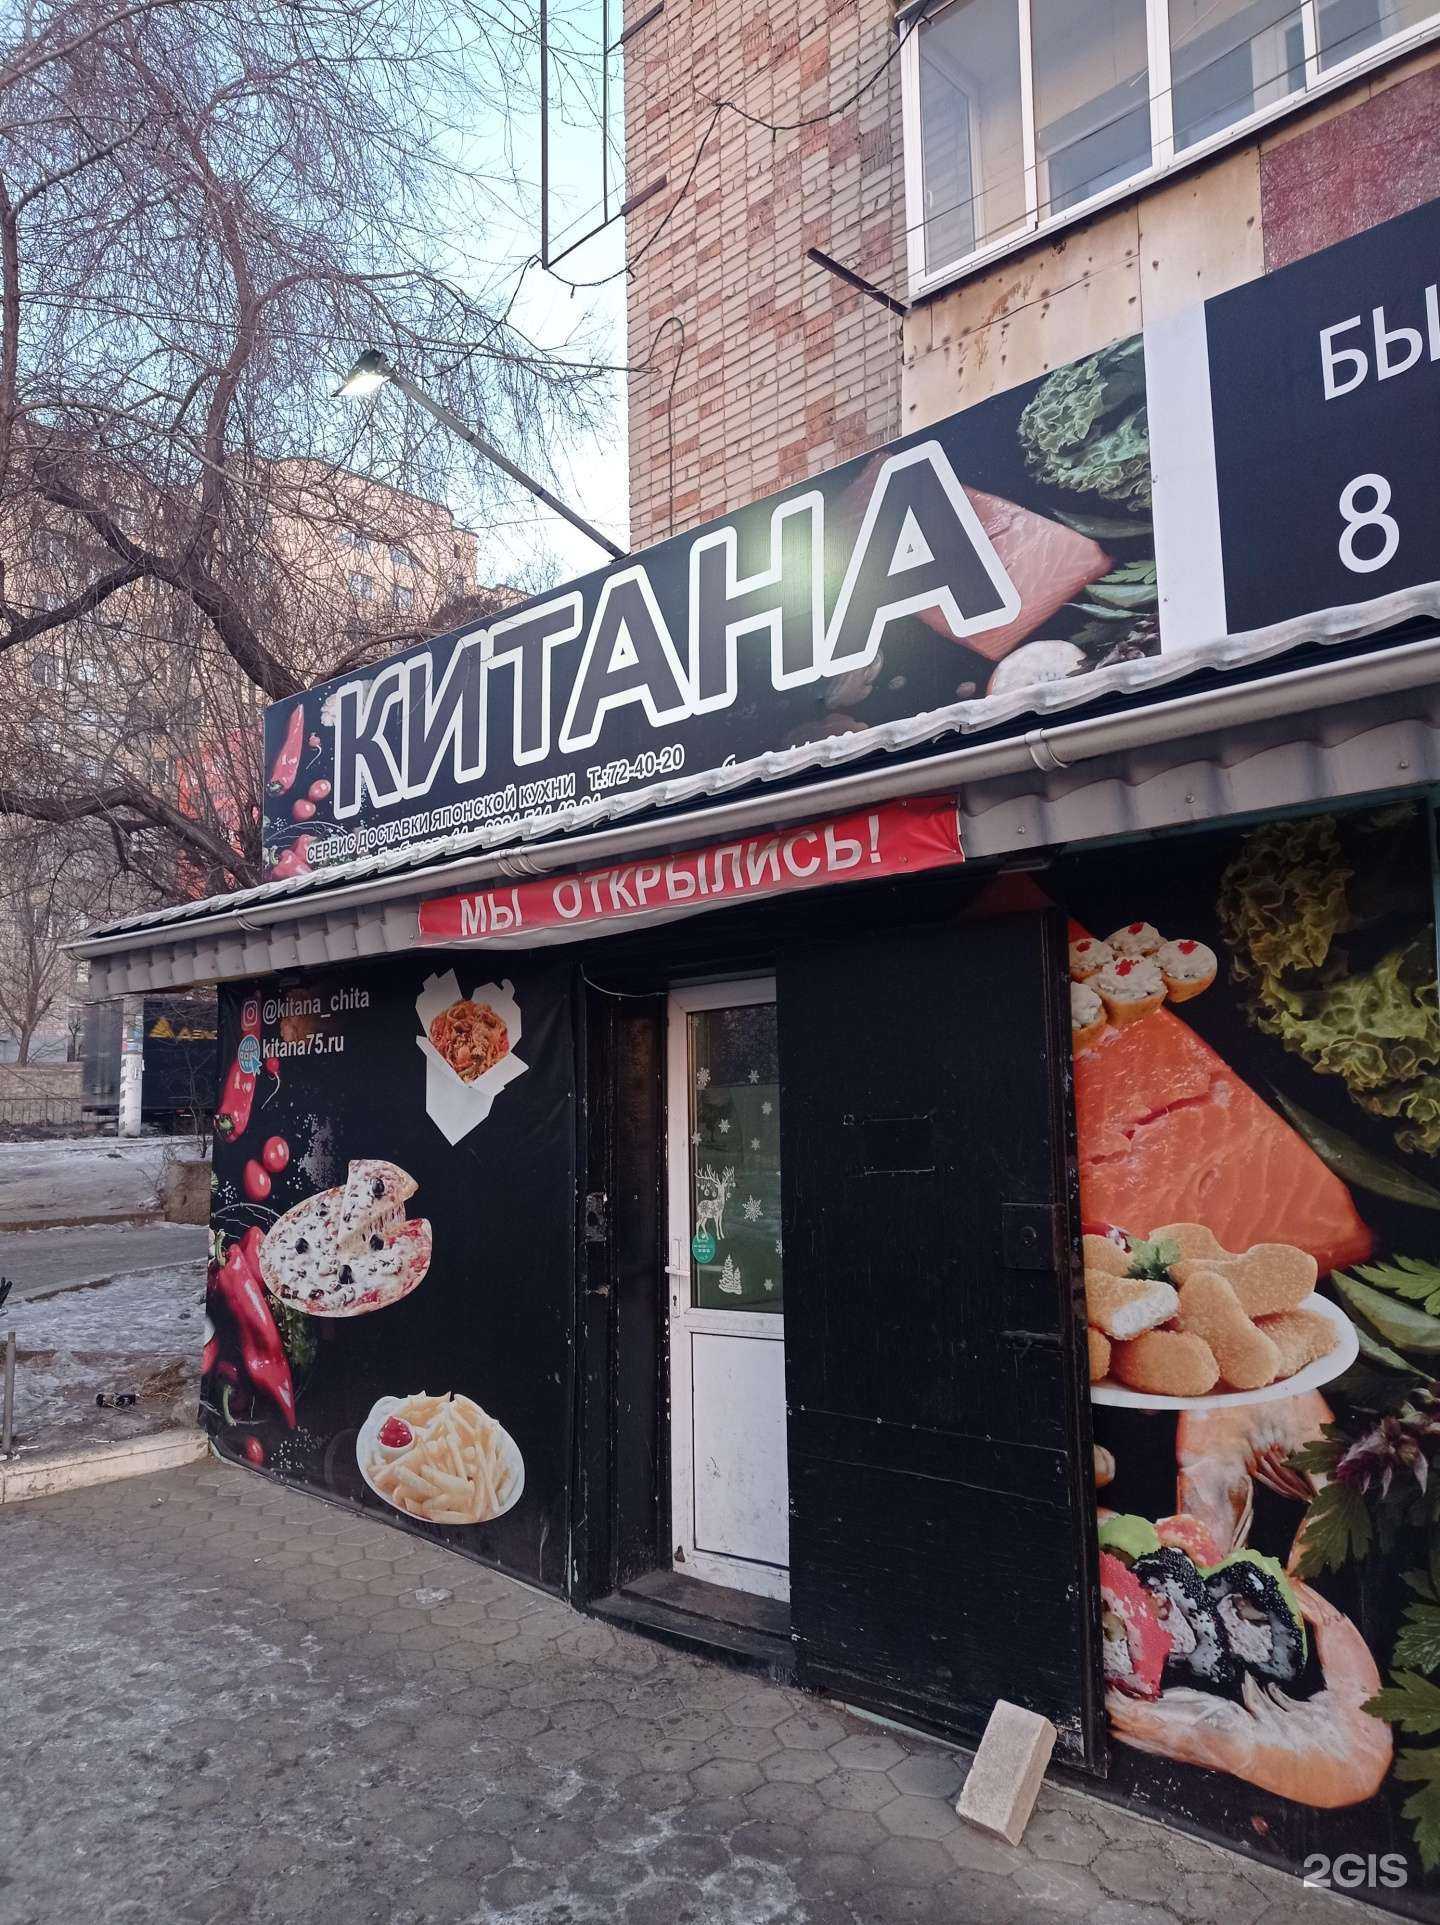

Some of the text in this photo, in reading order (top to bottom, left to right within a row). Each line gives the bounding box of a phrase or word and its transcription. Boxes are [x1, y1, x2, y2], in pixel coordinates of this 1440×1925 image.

[1319, 283, 1440, 401] БЫ
[1339, 473, 1400, 574] 8
[333, 440, 1022, 819] КИТАНА
[307, 833, 357, 863] СЕРВИС
[356, 811, 430, 854] ДОСТАВКИ
[430, 784, 517, 831] ЯПОНСКОЙ
[519, 773, 576, 809] КУХНИ
[460, 814, 881, 936] МЫ ОТКРЫЛИСЬ!
[262, 987, 370, 1025] @kitana_chita
[262, 1033, 345, 1059] kitana75.ru
